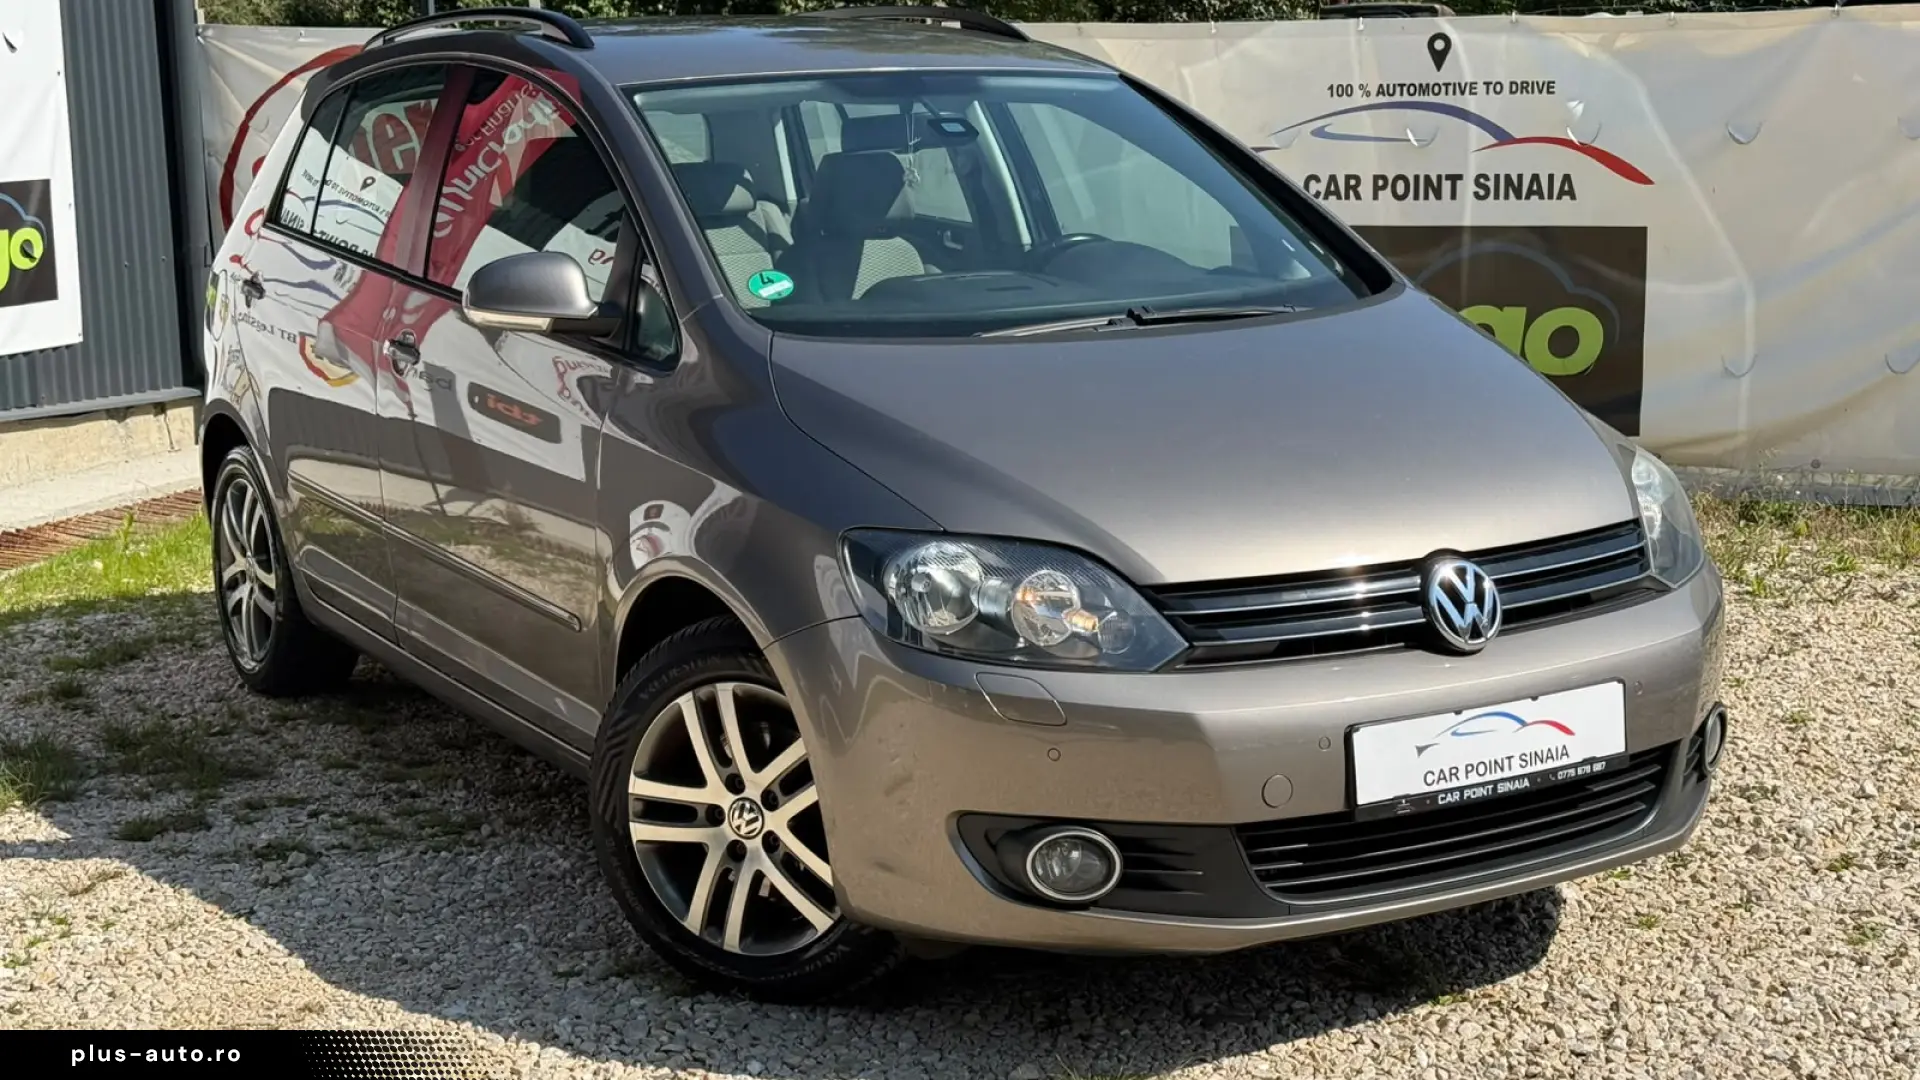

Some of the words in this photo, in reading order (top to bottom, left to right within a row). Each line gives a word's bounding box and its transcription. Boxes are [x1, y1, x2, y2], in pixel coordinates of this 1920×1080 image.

[1327, 83, 1354, 98] 100
[1358, 83, 1371, 98] %
[1375, 81, 1478, 98] AUTOMOTIVE
[1483, 80, 1504, 96] TO
[1508, 80, 1556, 96] DRIVE
[1303, 173, 1362, 201] CAR
[1372, 173, 1464, 201] POINT
[1473, 173, 1577, 201] SINAIA
[1428, 557, 1502, 652] VW
[1423, 766, 1460, 787] CAR
[1465, 755, 1515, 780] POINT
[1519, 744, 1570, 769] SINAIA
[1438, 791, 1460, 805] CAR
[1463, 784, 1494, 800] POINT
[1497, 777, 1530, 794] SINAIA
